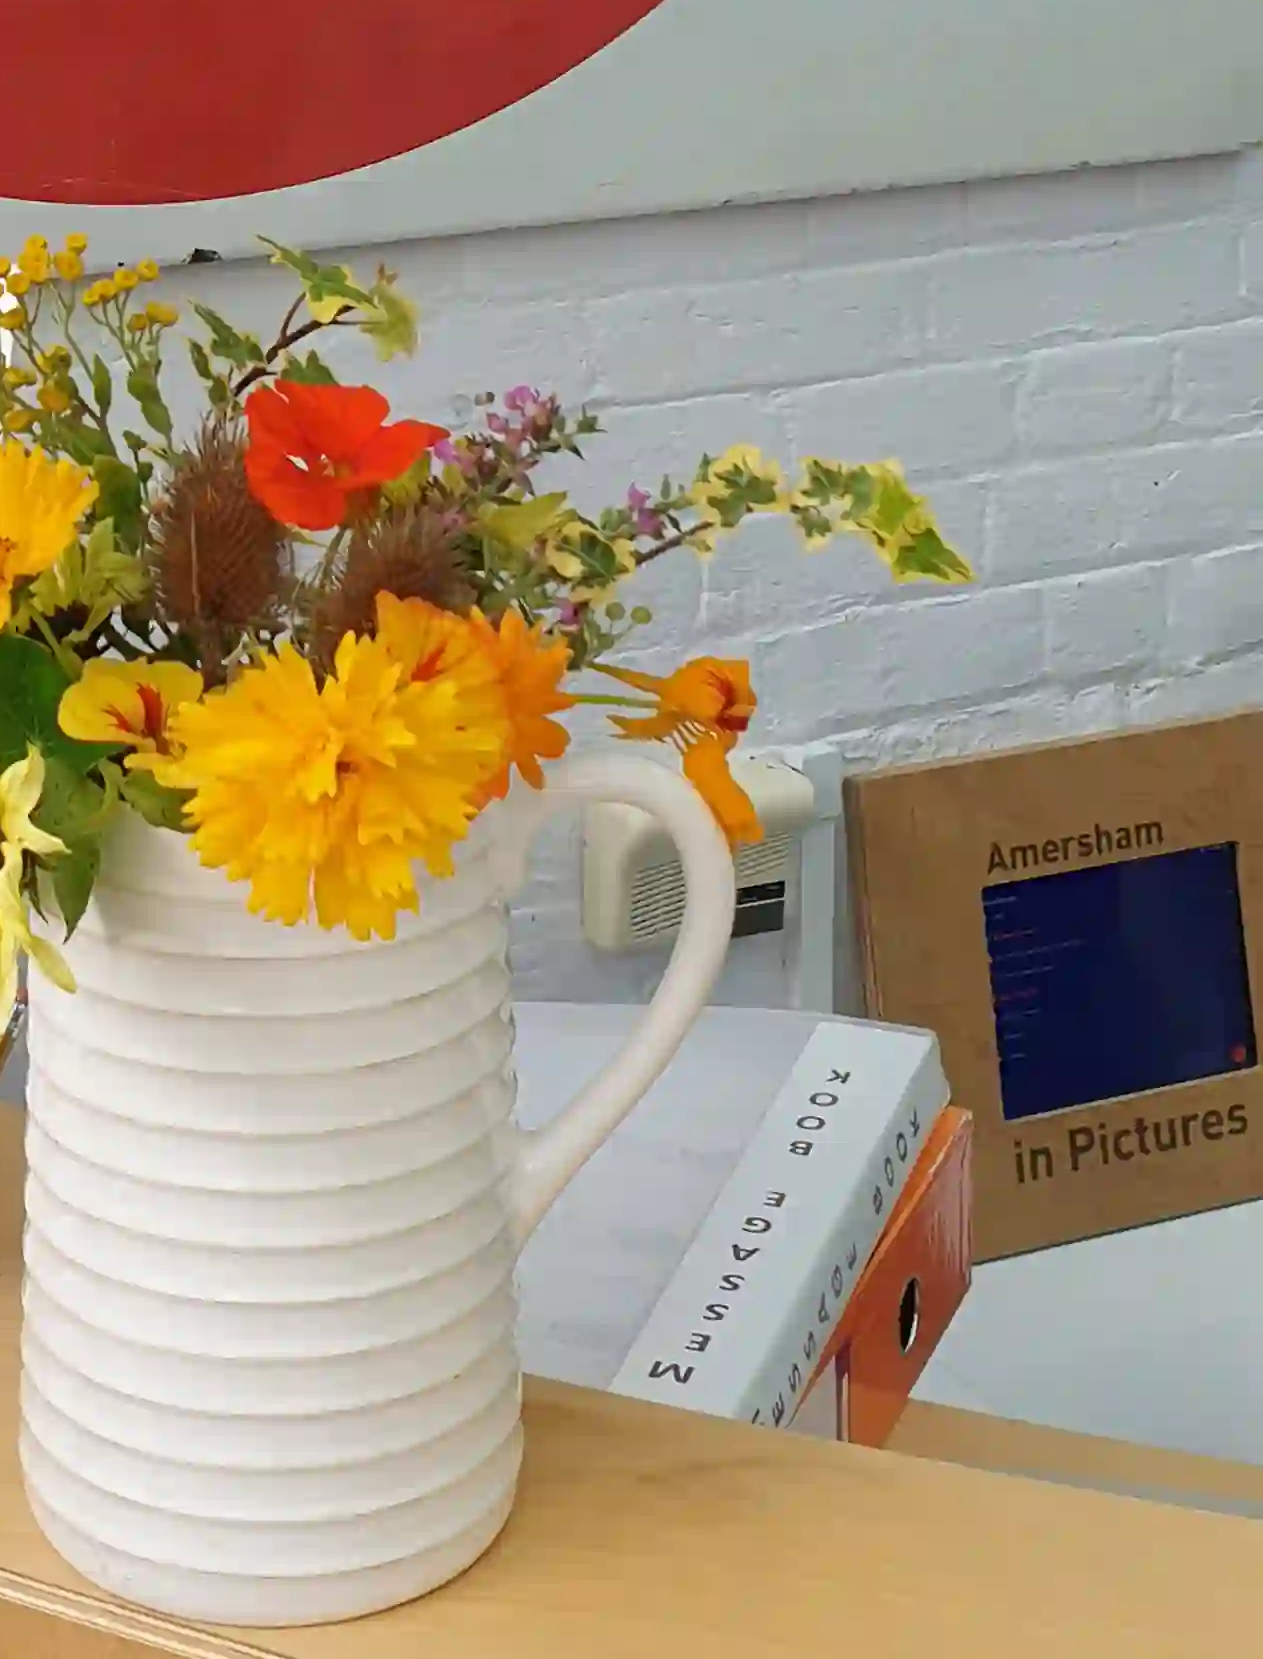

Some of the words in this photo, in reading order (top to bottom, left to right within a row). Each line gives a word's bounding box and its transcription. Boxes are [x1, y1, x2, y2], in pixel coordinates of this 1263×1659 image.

[987, 820, 1165, 875] Amersham
[1014, 1140, 1054, 1184] in
[1068, 1103, 1249, 1172] Pictures
[648, 1191, 787, 1384] MESSAGE
[788, 1068, 851, 1157] BOOK
